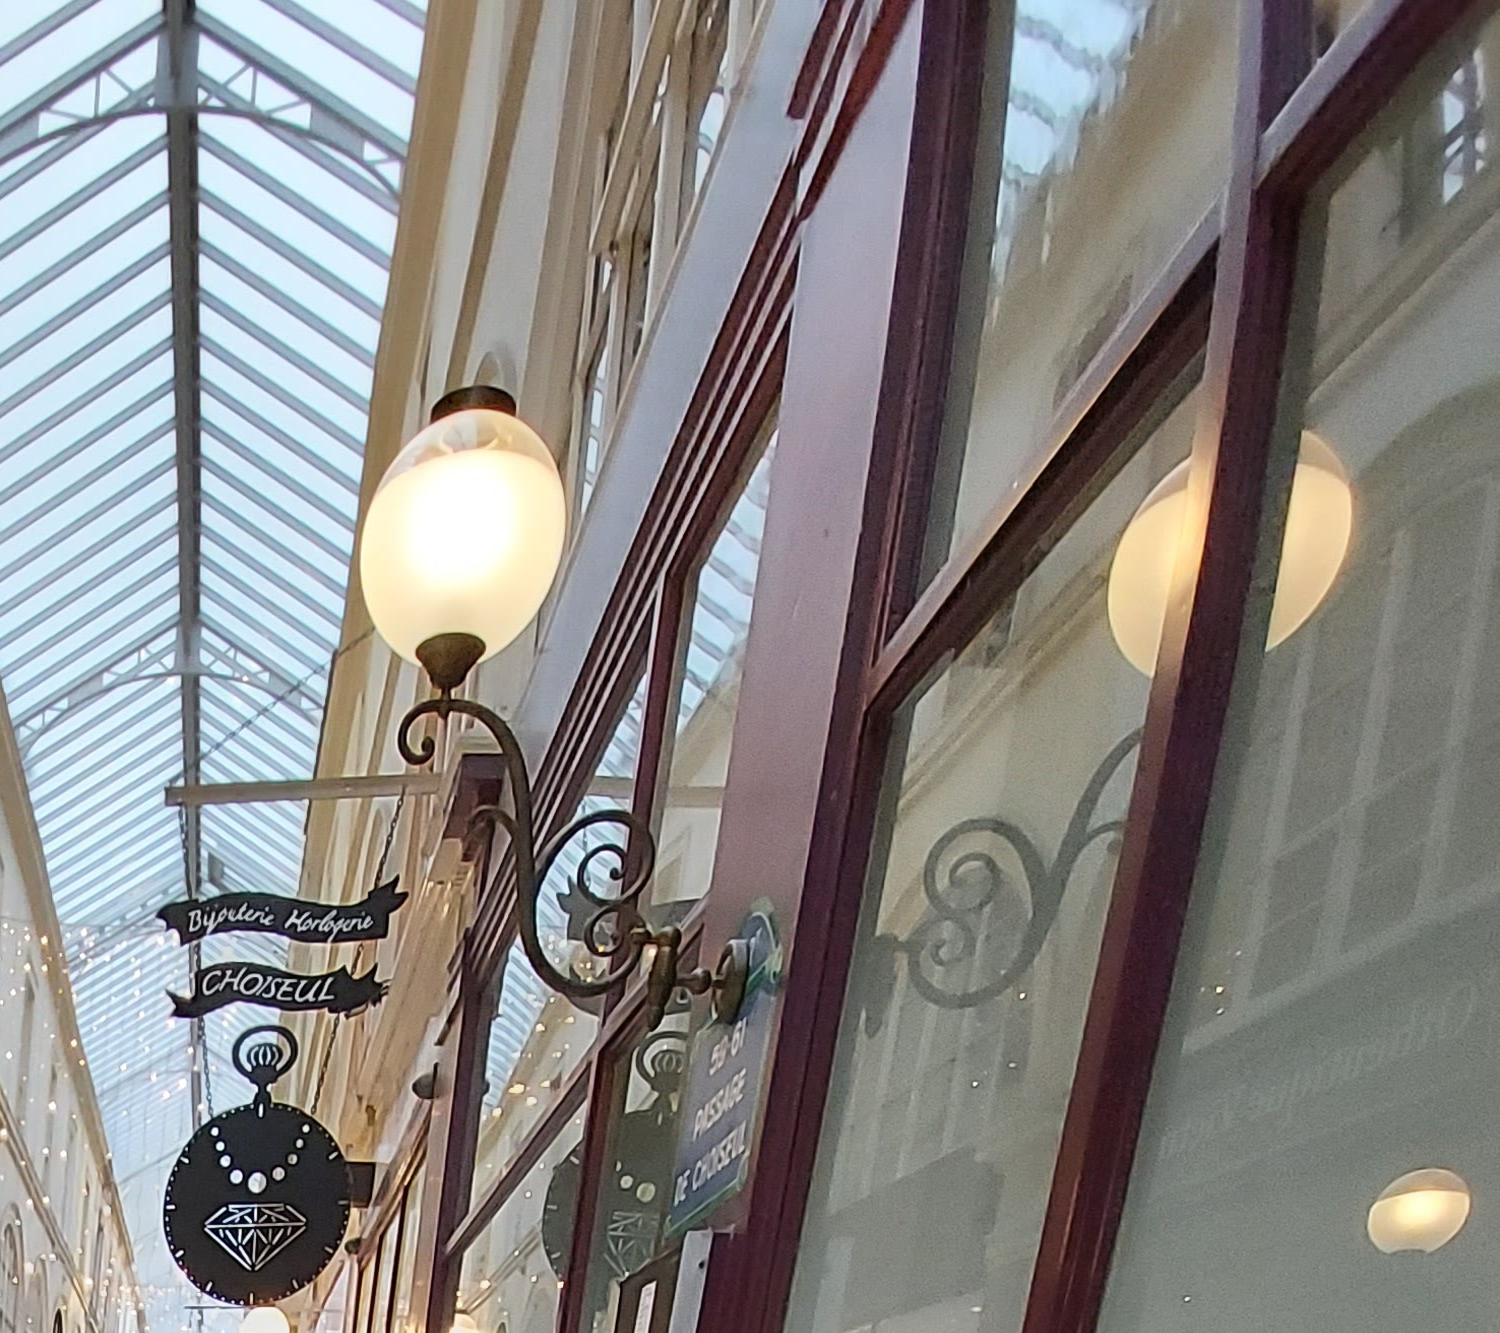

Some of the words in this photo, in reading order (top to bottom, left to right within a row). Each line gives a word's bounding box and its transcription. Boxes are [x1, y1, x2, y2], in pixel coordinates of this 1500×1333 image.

[187, 902, 276, 934] Bijouterie
[285, 905, 375, 941] Horlogerie
[201, 967, 336, 1003] CHOISEUL
